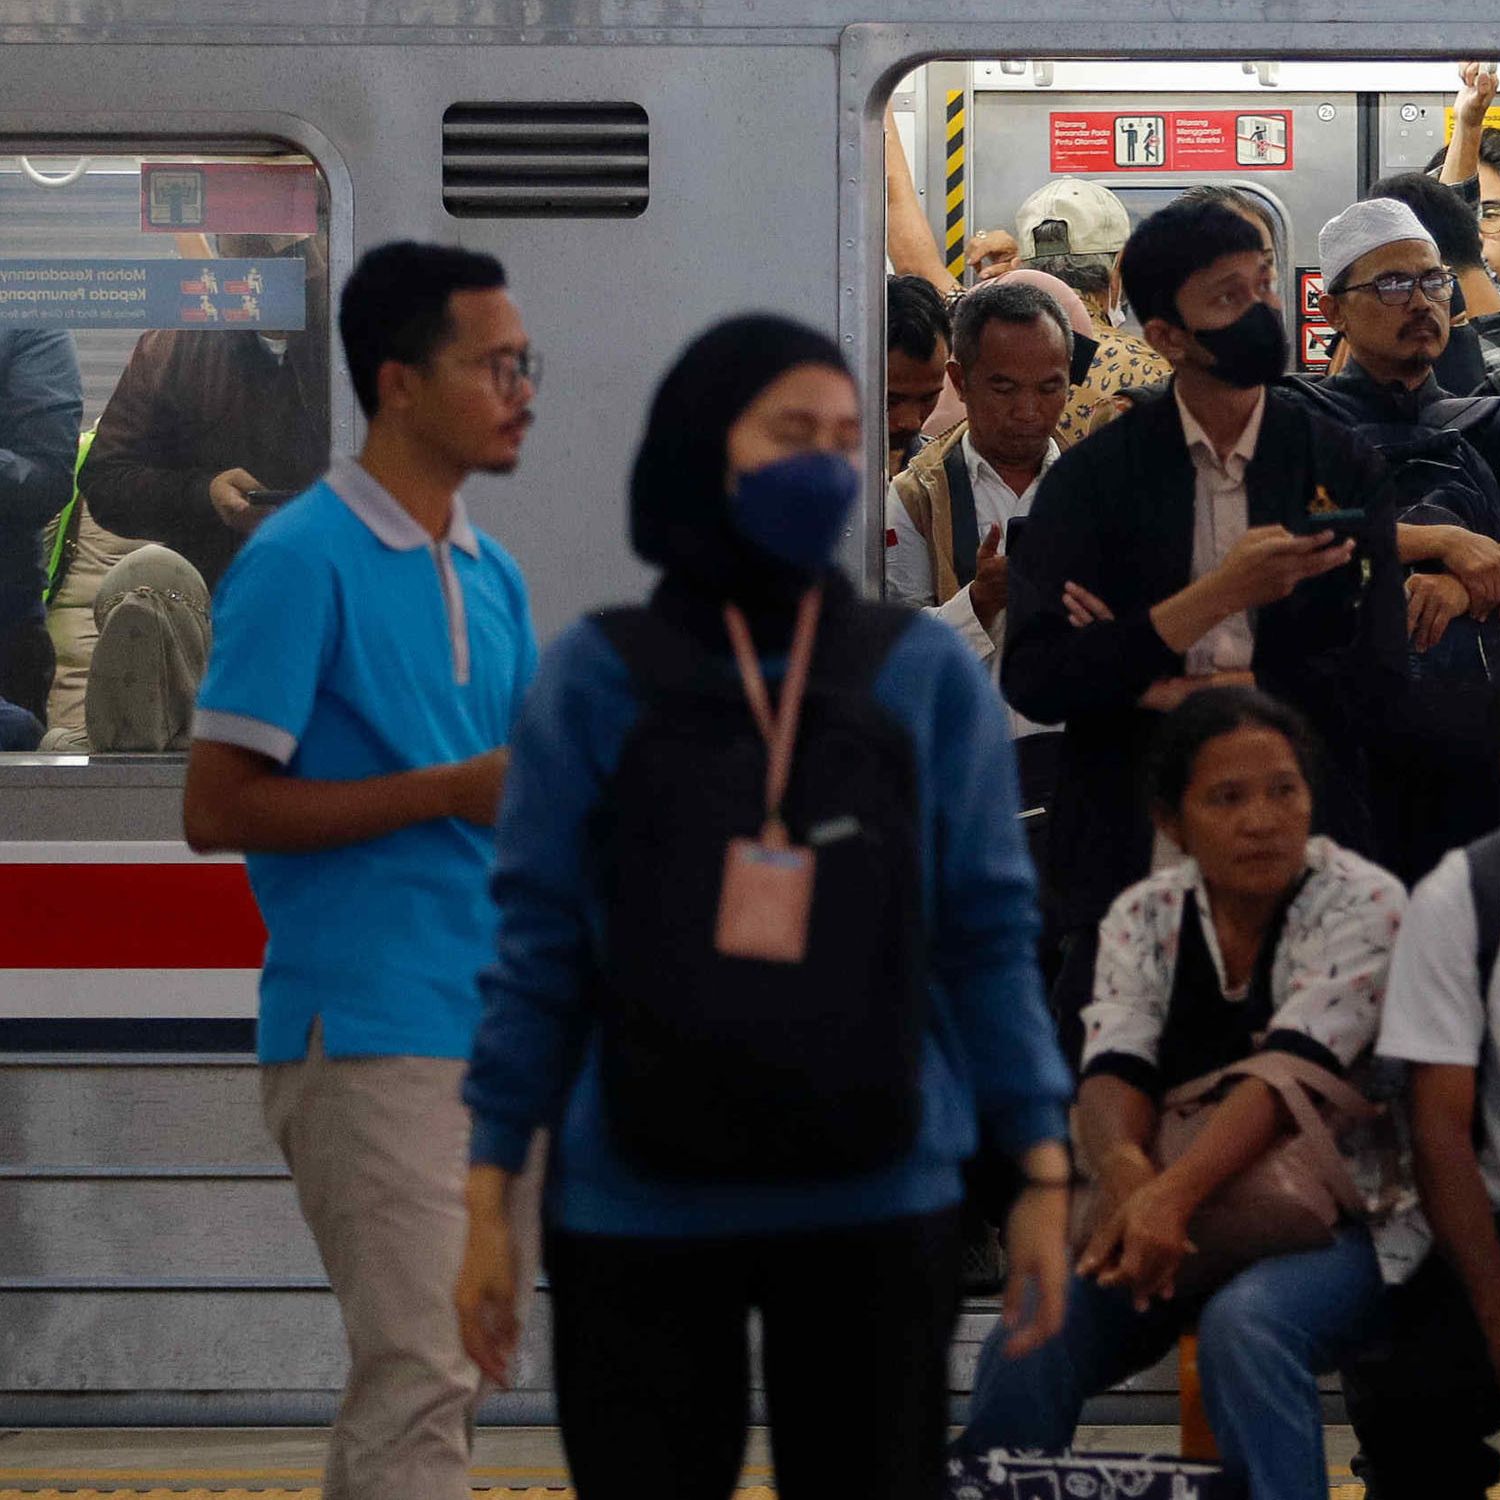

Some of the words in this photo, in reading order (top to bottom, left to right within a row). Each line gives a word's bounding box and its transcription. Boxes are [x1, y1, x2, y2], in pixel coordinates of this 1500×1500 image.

[1055, 121, 1088, 129] Dilarang
[1176, 119, 1209, 128] Dilarang
[1176, 128, 1222, 137] Mengganjal
[1177, 136, 1195, 144] Pintu
